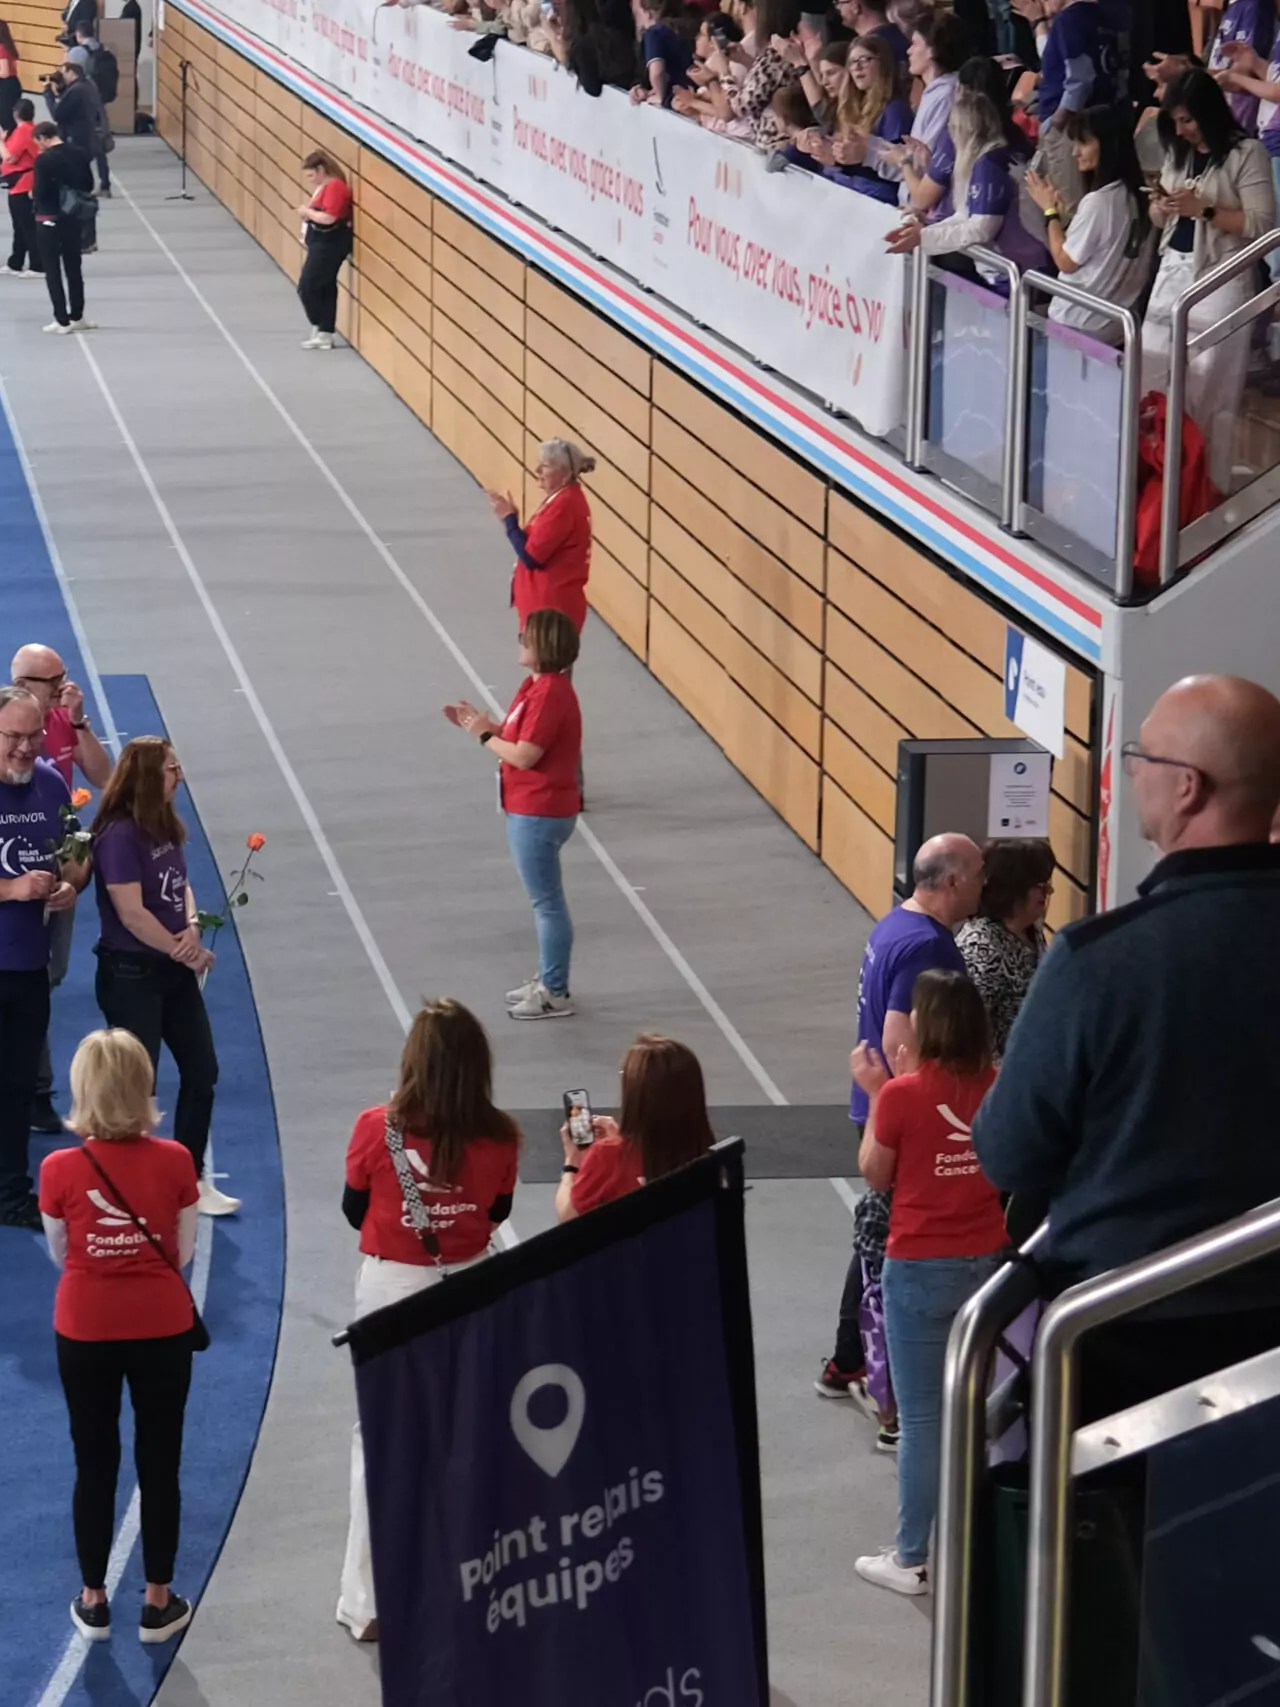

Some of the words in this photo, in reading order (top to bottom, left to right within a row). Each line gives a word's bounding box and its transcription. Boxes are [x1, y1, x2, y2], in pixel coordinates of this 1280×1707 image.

[687, 195, 713, 254] Pour
[714, 224, 740, 282] vous,
[743, 238, 771, 291] avec
[771, 252, 805, 316] vous,
[806, 263, 844, 330] grâce
[845, 277, 862, 334] à
[86, 1232, 162, 1246] Fondatin
[401, 1215, 456, 1229] Ccer
[86, 1245, 140, 1258] Cancer
[460, 1515, 549, 1603] Point
[559, 1466, 665, 1547] relais
[486, 1536, 635, 1634] équipes
